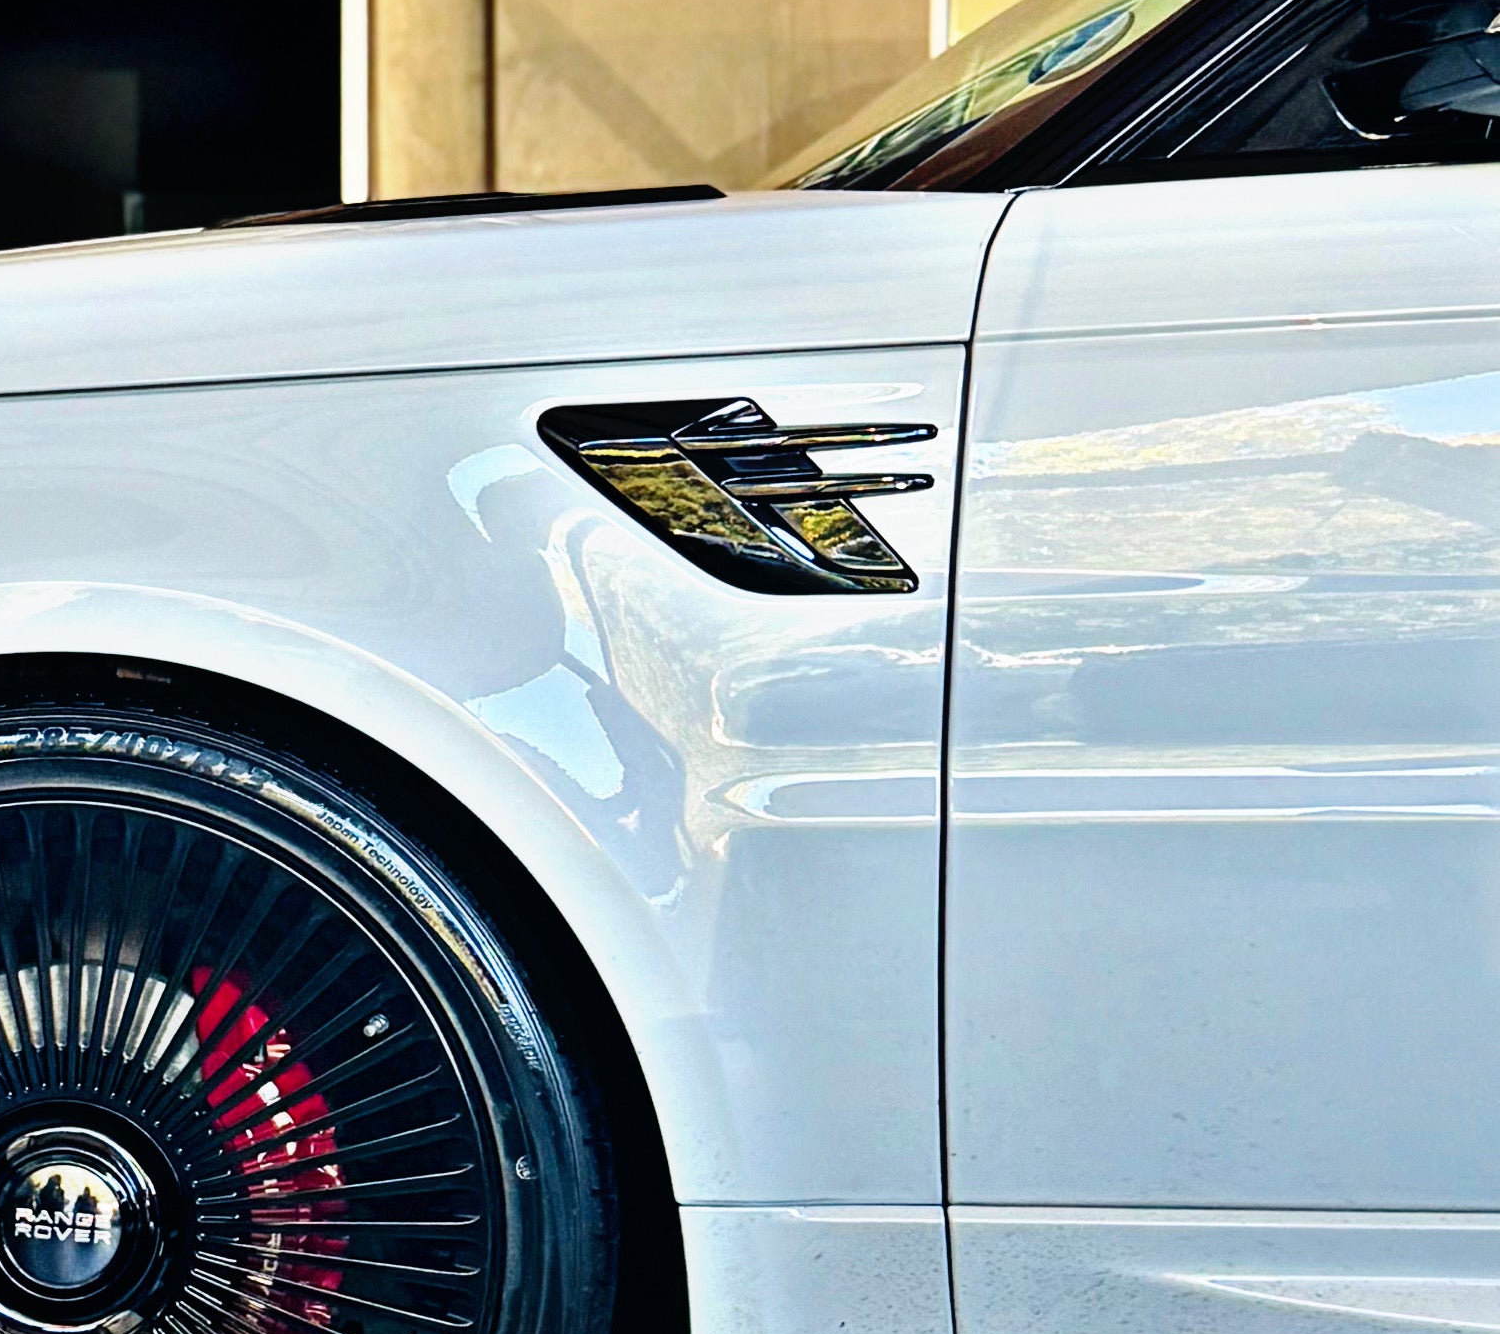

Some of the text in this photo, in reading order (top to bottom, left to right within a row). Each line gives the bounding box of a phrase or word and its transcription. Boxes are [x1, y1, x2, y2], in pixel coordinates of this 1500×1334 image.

[315, 810, 435, 911] Japan Technology
[15, 1207, 114, 1229] RANGE
[14, 1222, 113, 1245] ROVER
